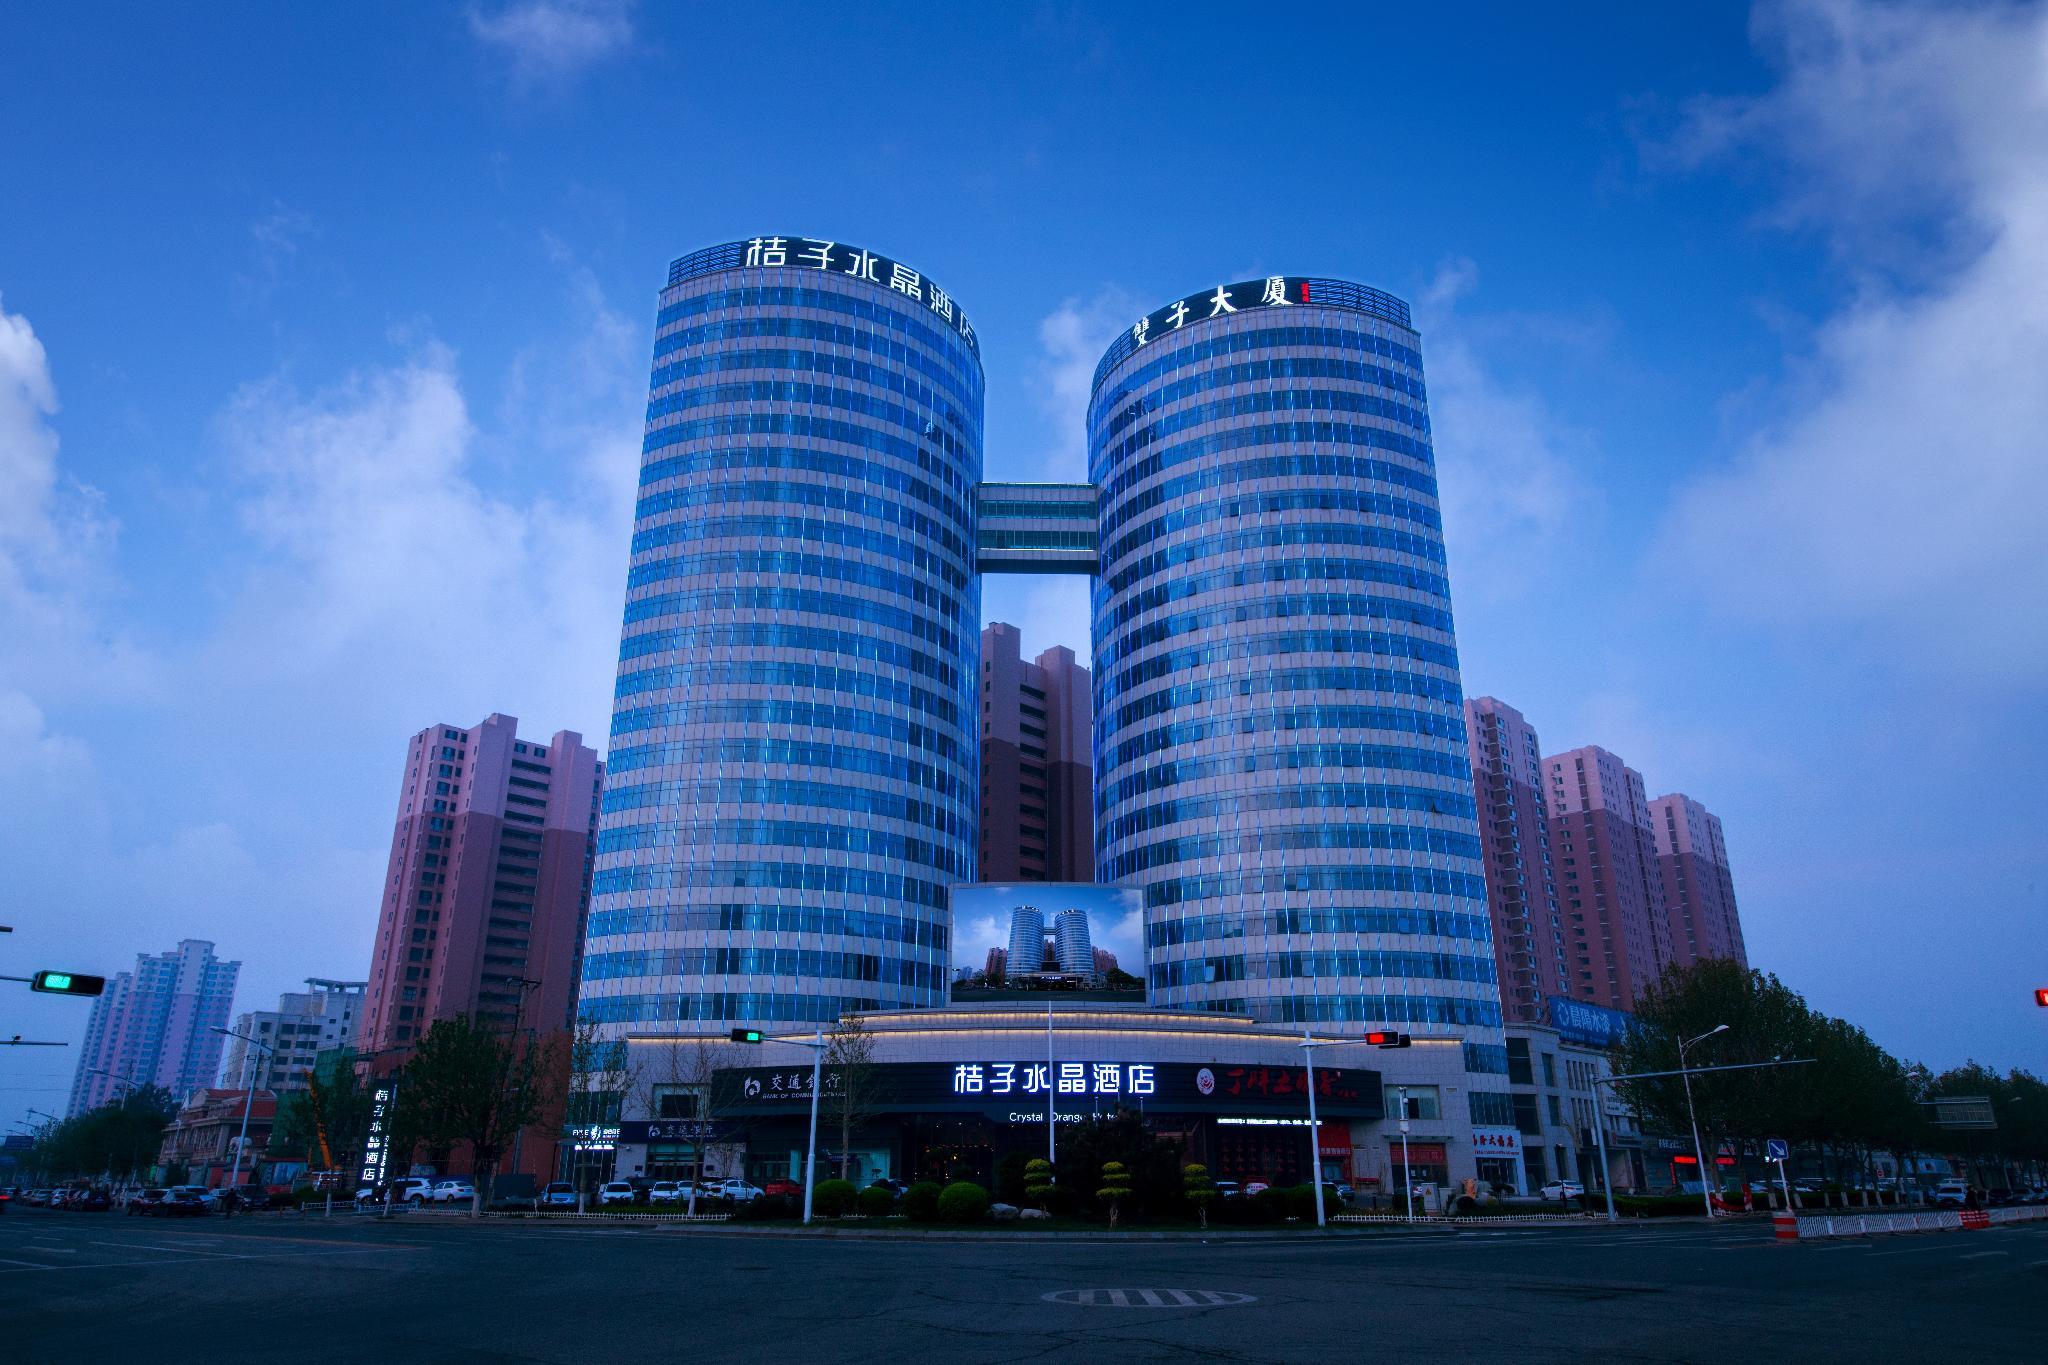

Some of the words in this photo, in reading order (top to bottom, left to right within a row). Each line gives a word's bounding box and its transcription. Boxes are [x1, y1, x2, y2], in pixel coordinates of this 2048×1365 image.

[746, 236, 974, 349] 桔子水晶酒店
[954, 1063, 1156, 1095] 桔子水晶酒店
[1009, 1112, 1043, 1123] Crystal
